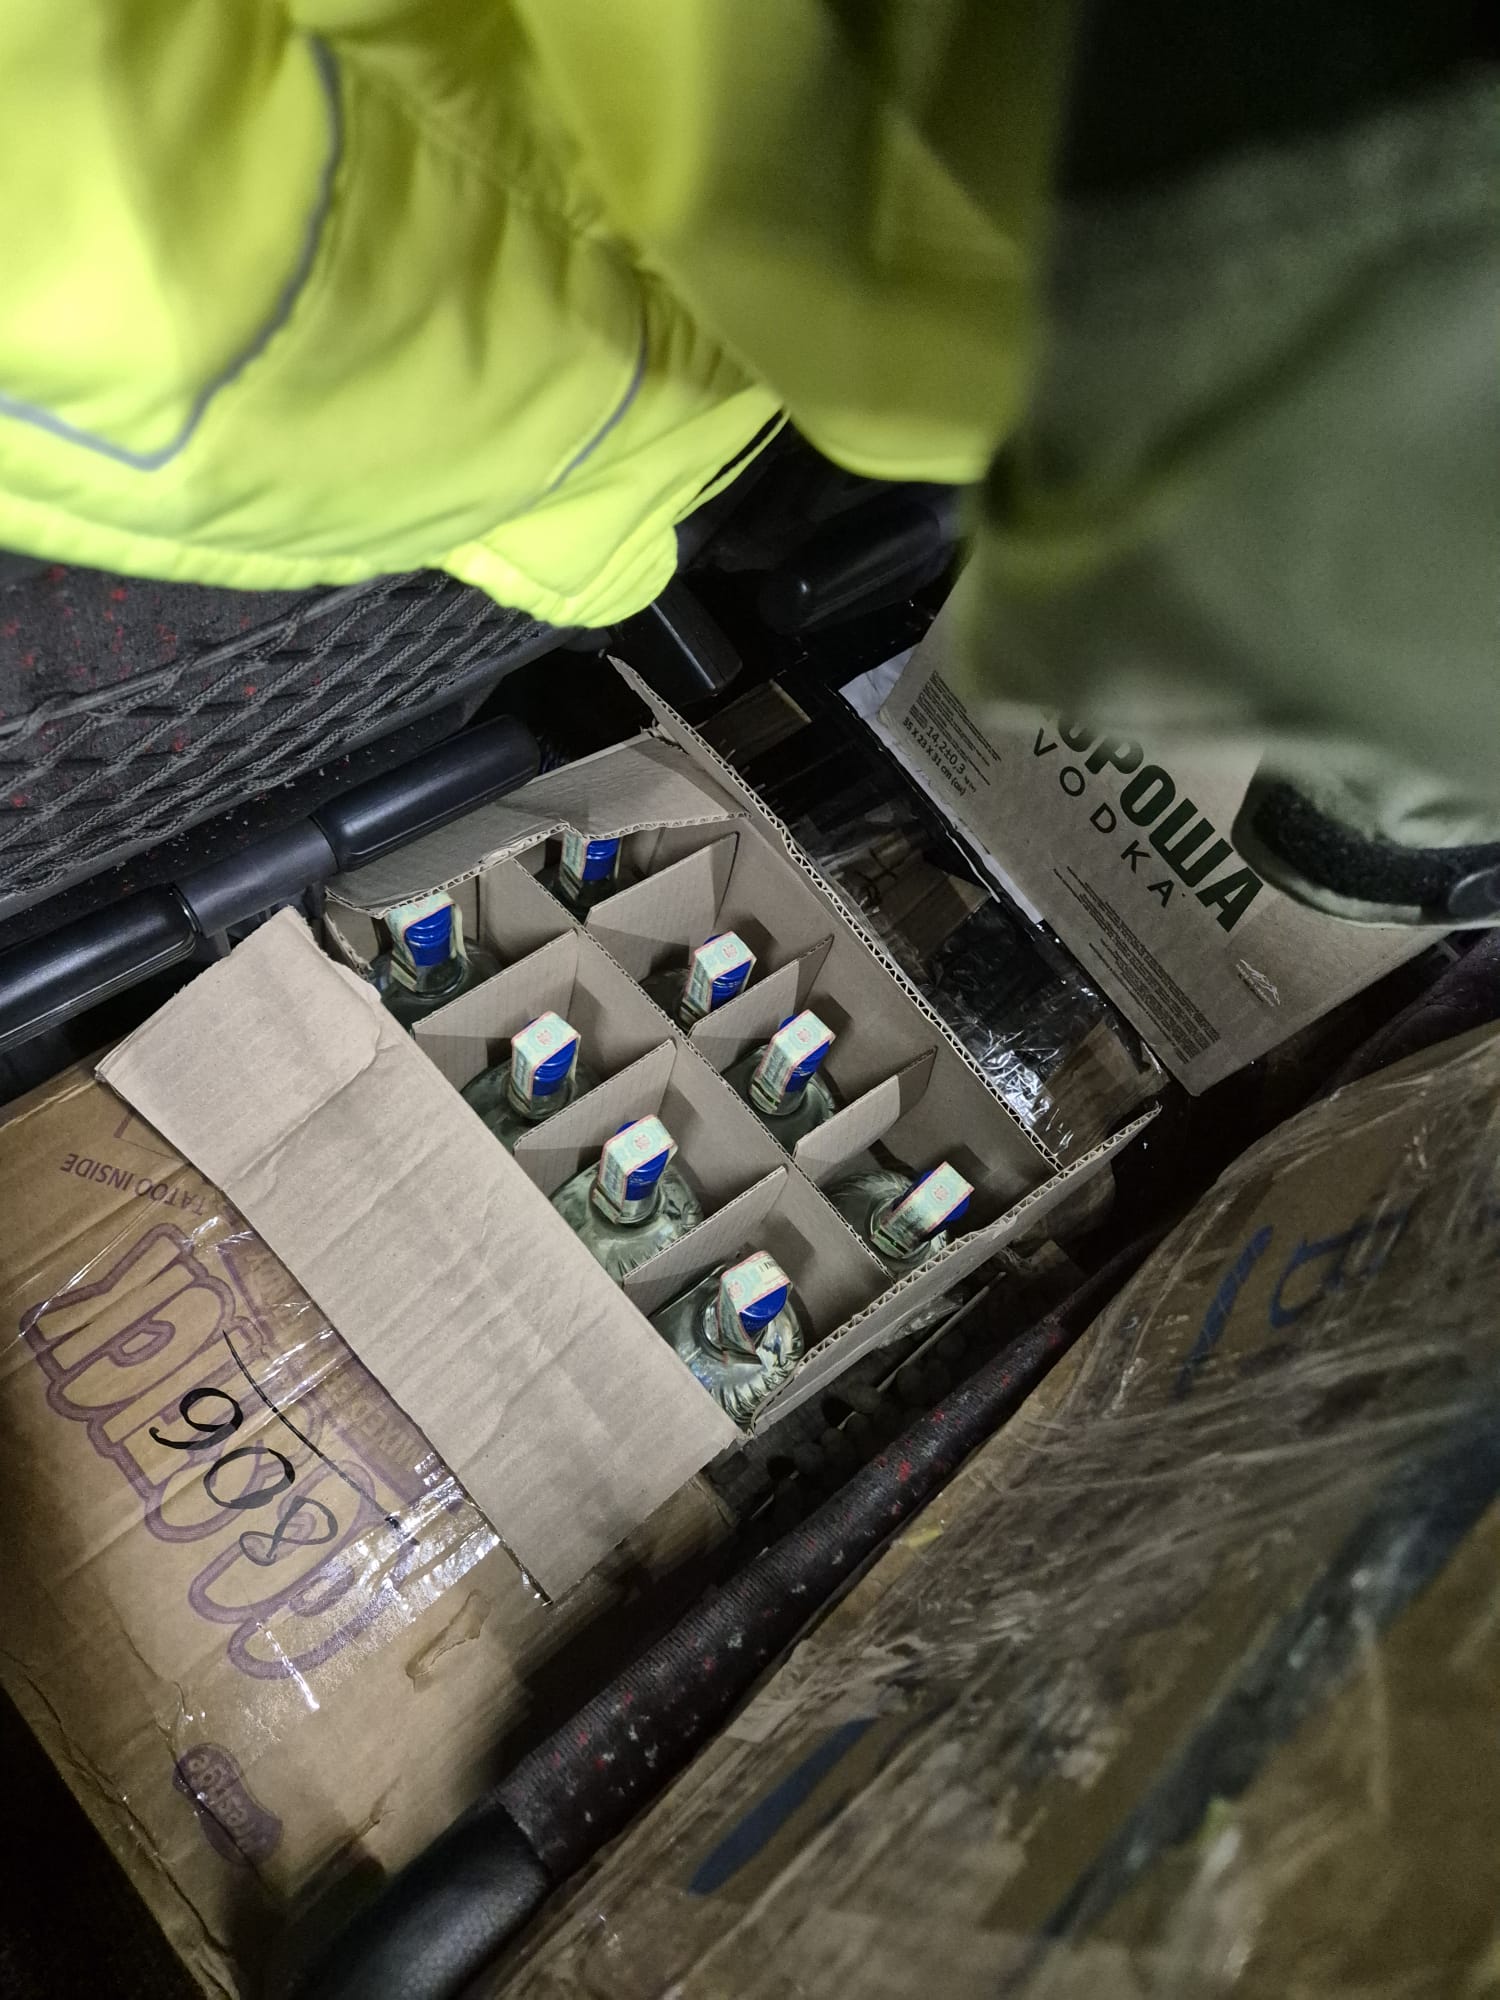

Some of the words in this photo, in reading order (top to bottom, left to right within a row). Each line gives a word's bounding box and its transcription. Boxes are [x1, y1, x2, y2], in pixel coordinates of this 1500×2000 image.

[1033, 727, 1175, 908] VODKA
[1055, 710, 1264, 933] ОРОША
[60, 1153, 134, 1191] INSIDE
[134, 1178, 206, 1216] TATOO
